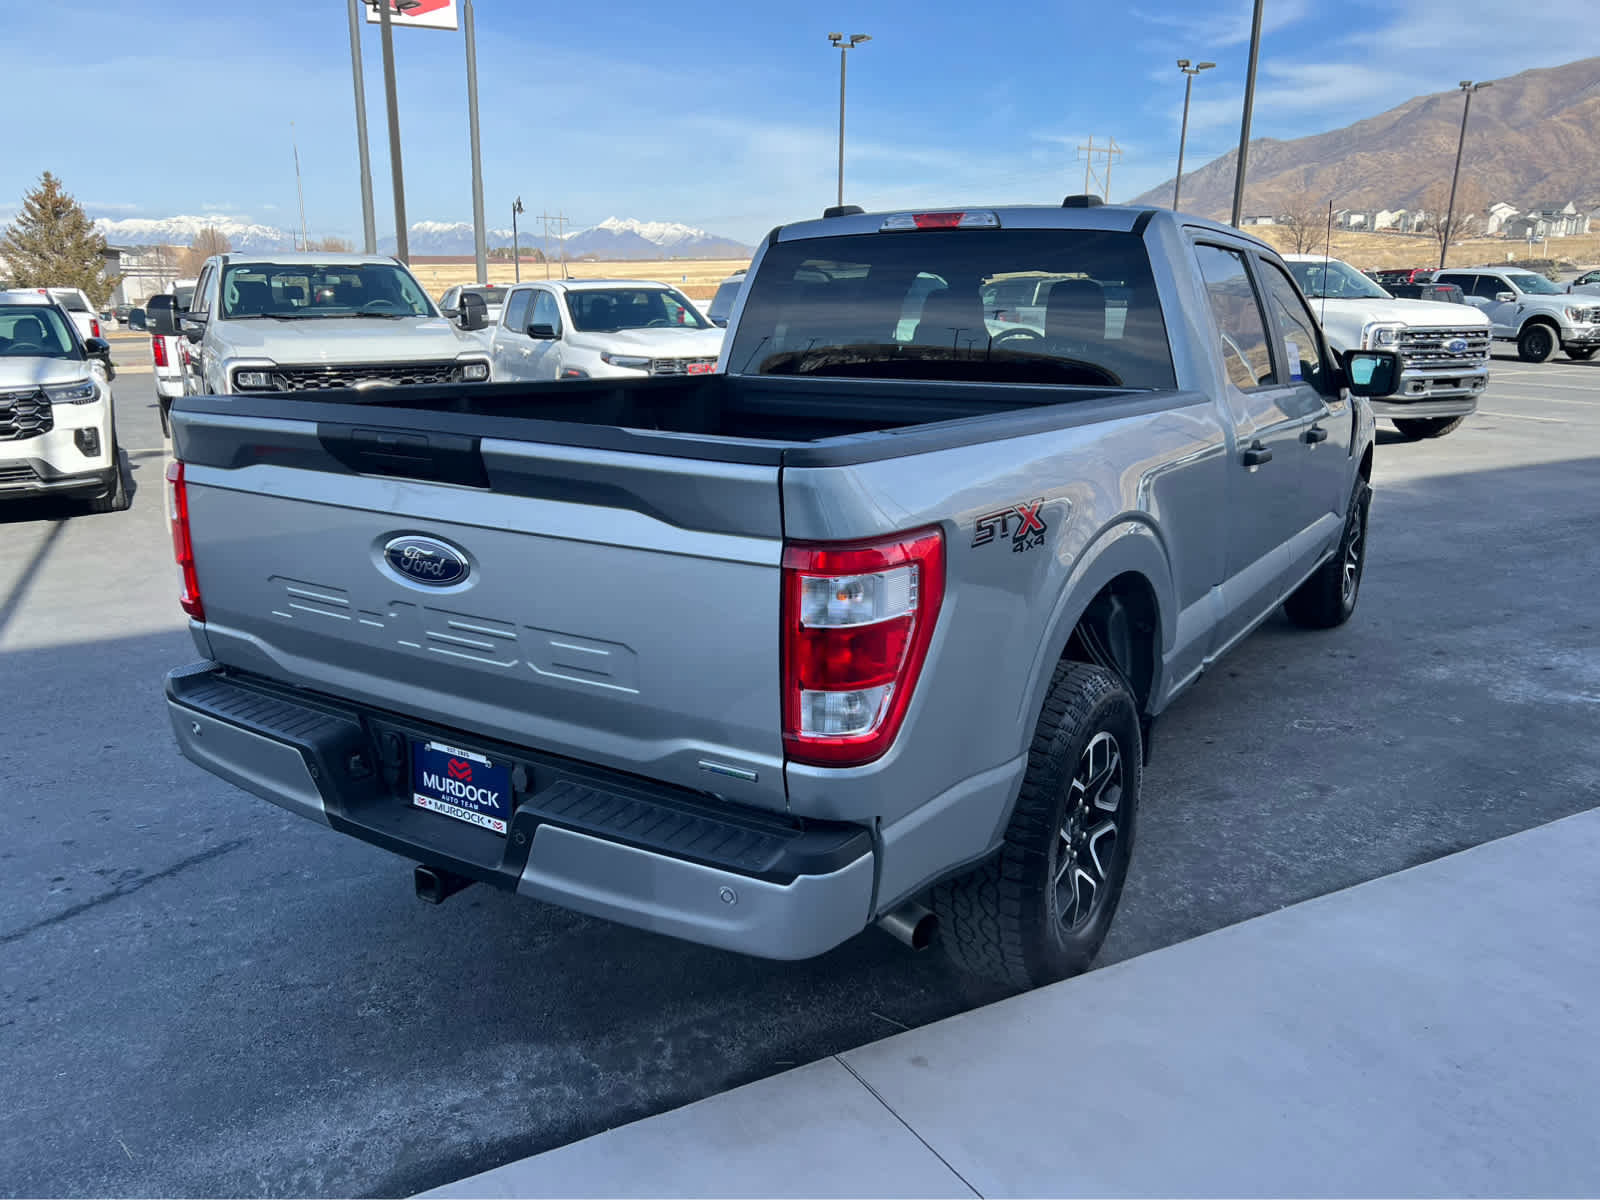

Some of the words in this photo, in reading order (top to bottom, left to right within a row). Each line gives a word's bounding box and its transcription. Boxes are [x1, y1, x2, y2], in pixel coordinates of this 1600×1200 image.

[687, 363, 718, 375] GM
[971, 497, 1047, 548] STX
[401, 546, 446, 576] Ford
[423, 771, 499, 809] MURDOCK
[441, 794, 459, 804] AUTO
[461, 799, 479, 810] TEAM
[434, 802, 486, 825] MURDOCK
